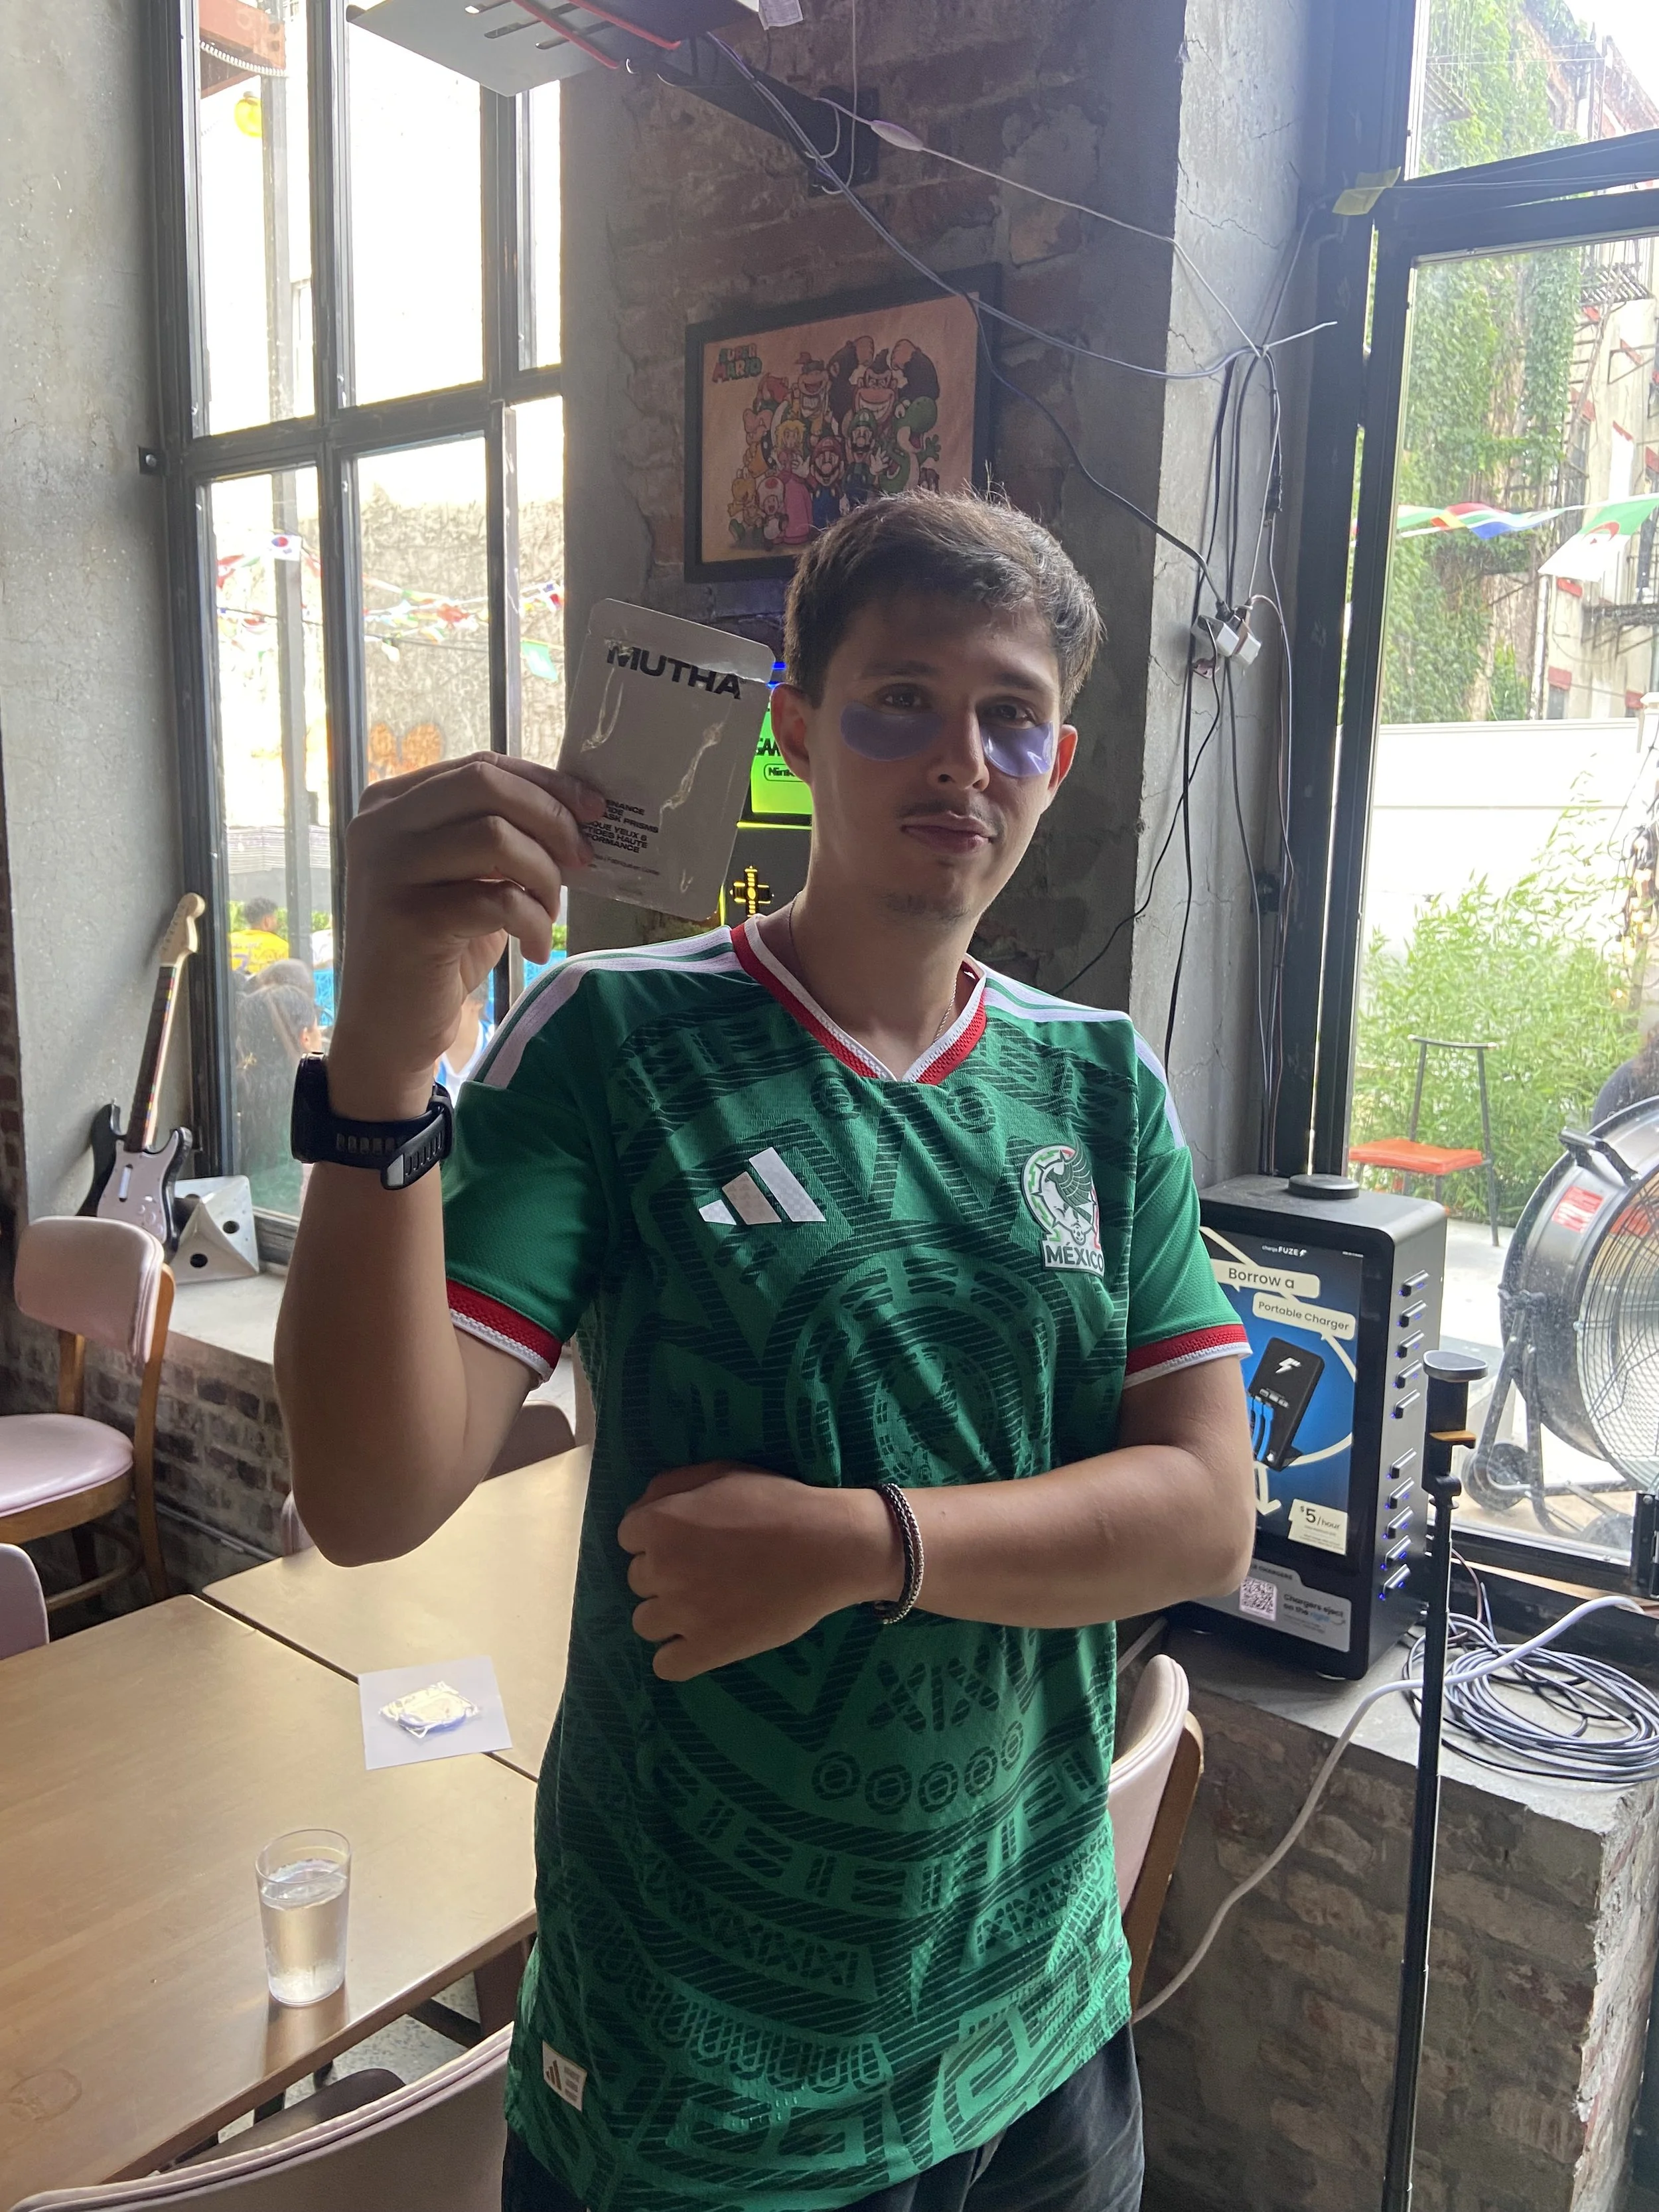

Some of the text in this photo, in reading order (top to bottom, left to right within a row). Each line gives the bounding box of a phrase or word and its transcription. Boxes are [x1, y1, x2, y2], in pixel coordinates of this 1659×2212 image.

[719, 343, 757, 363] SUPER
[712, 356, 762, 383] MARIO
[607, 646, 741, 700] MUTHA
[614, 826, 639, 839] YEUX
[616, 834, 648, 849] HAUTE
[1045, 1242, 1104, 1272] MÉXICO
[1228, 1267, 1295, 1289] Borrow a
[1258, 1301, 1350, 1330] Portable Charger
